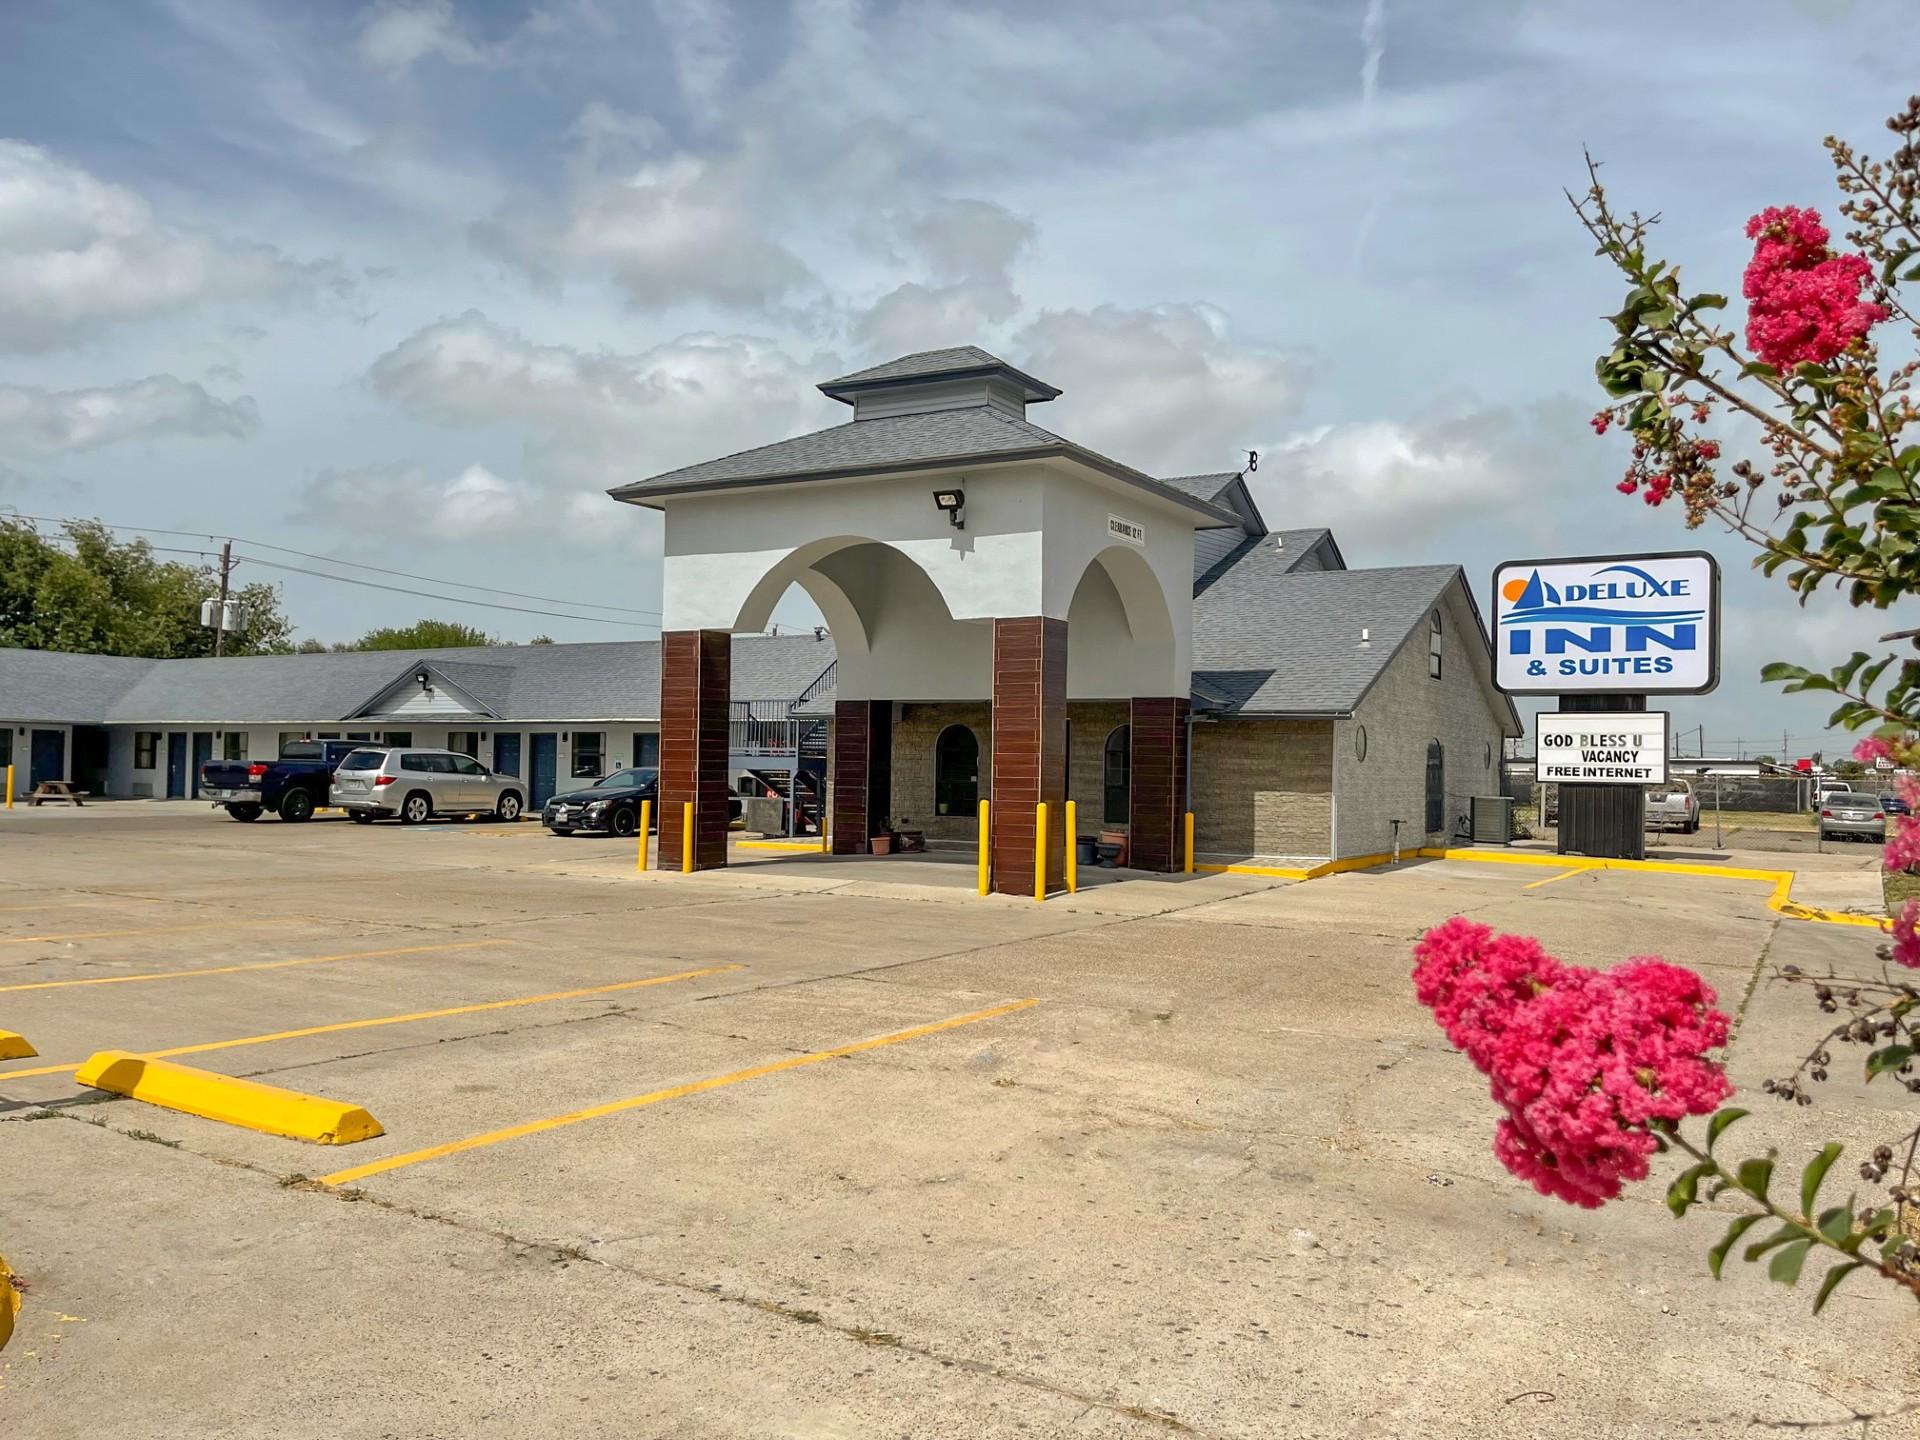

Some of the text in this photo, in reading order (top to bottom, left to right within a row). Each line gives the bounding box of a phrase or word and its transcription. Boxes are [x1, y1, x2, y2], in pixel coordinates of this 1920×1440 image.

[1565, 578, 1691, 602] DELUXE
[1510, 624, 1696, 655] INN
[1526, 656, 1673, 676] & SUITES
[1543, 734, 1643, 747] GOD BLESS U
[1581, 750, 1639, 763] VACANCY
[1547, 766, 1652, 779] FREE INTERNET
